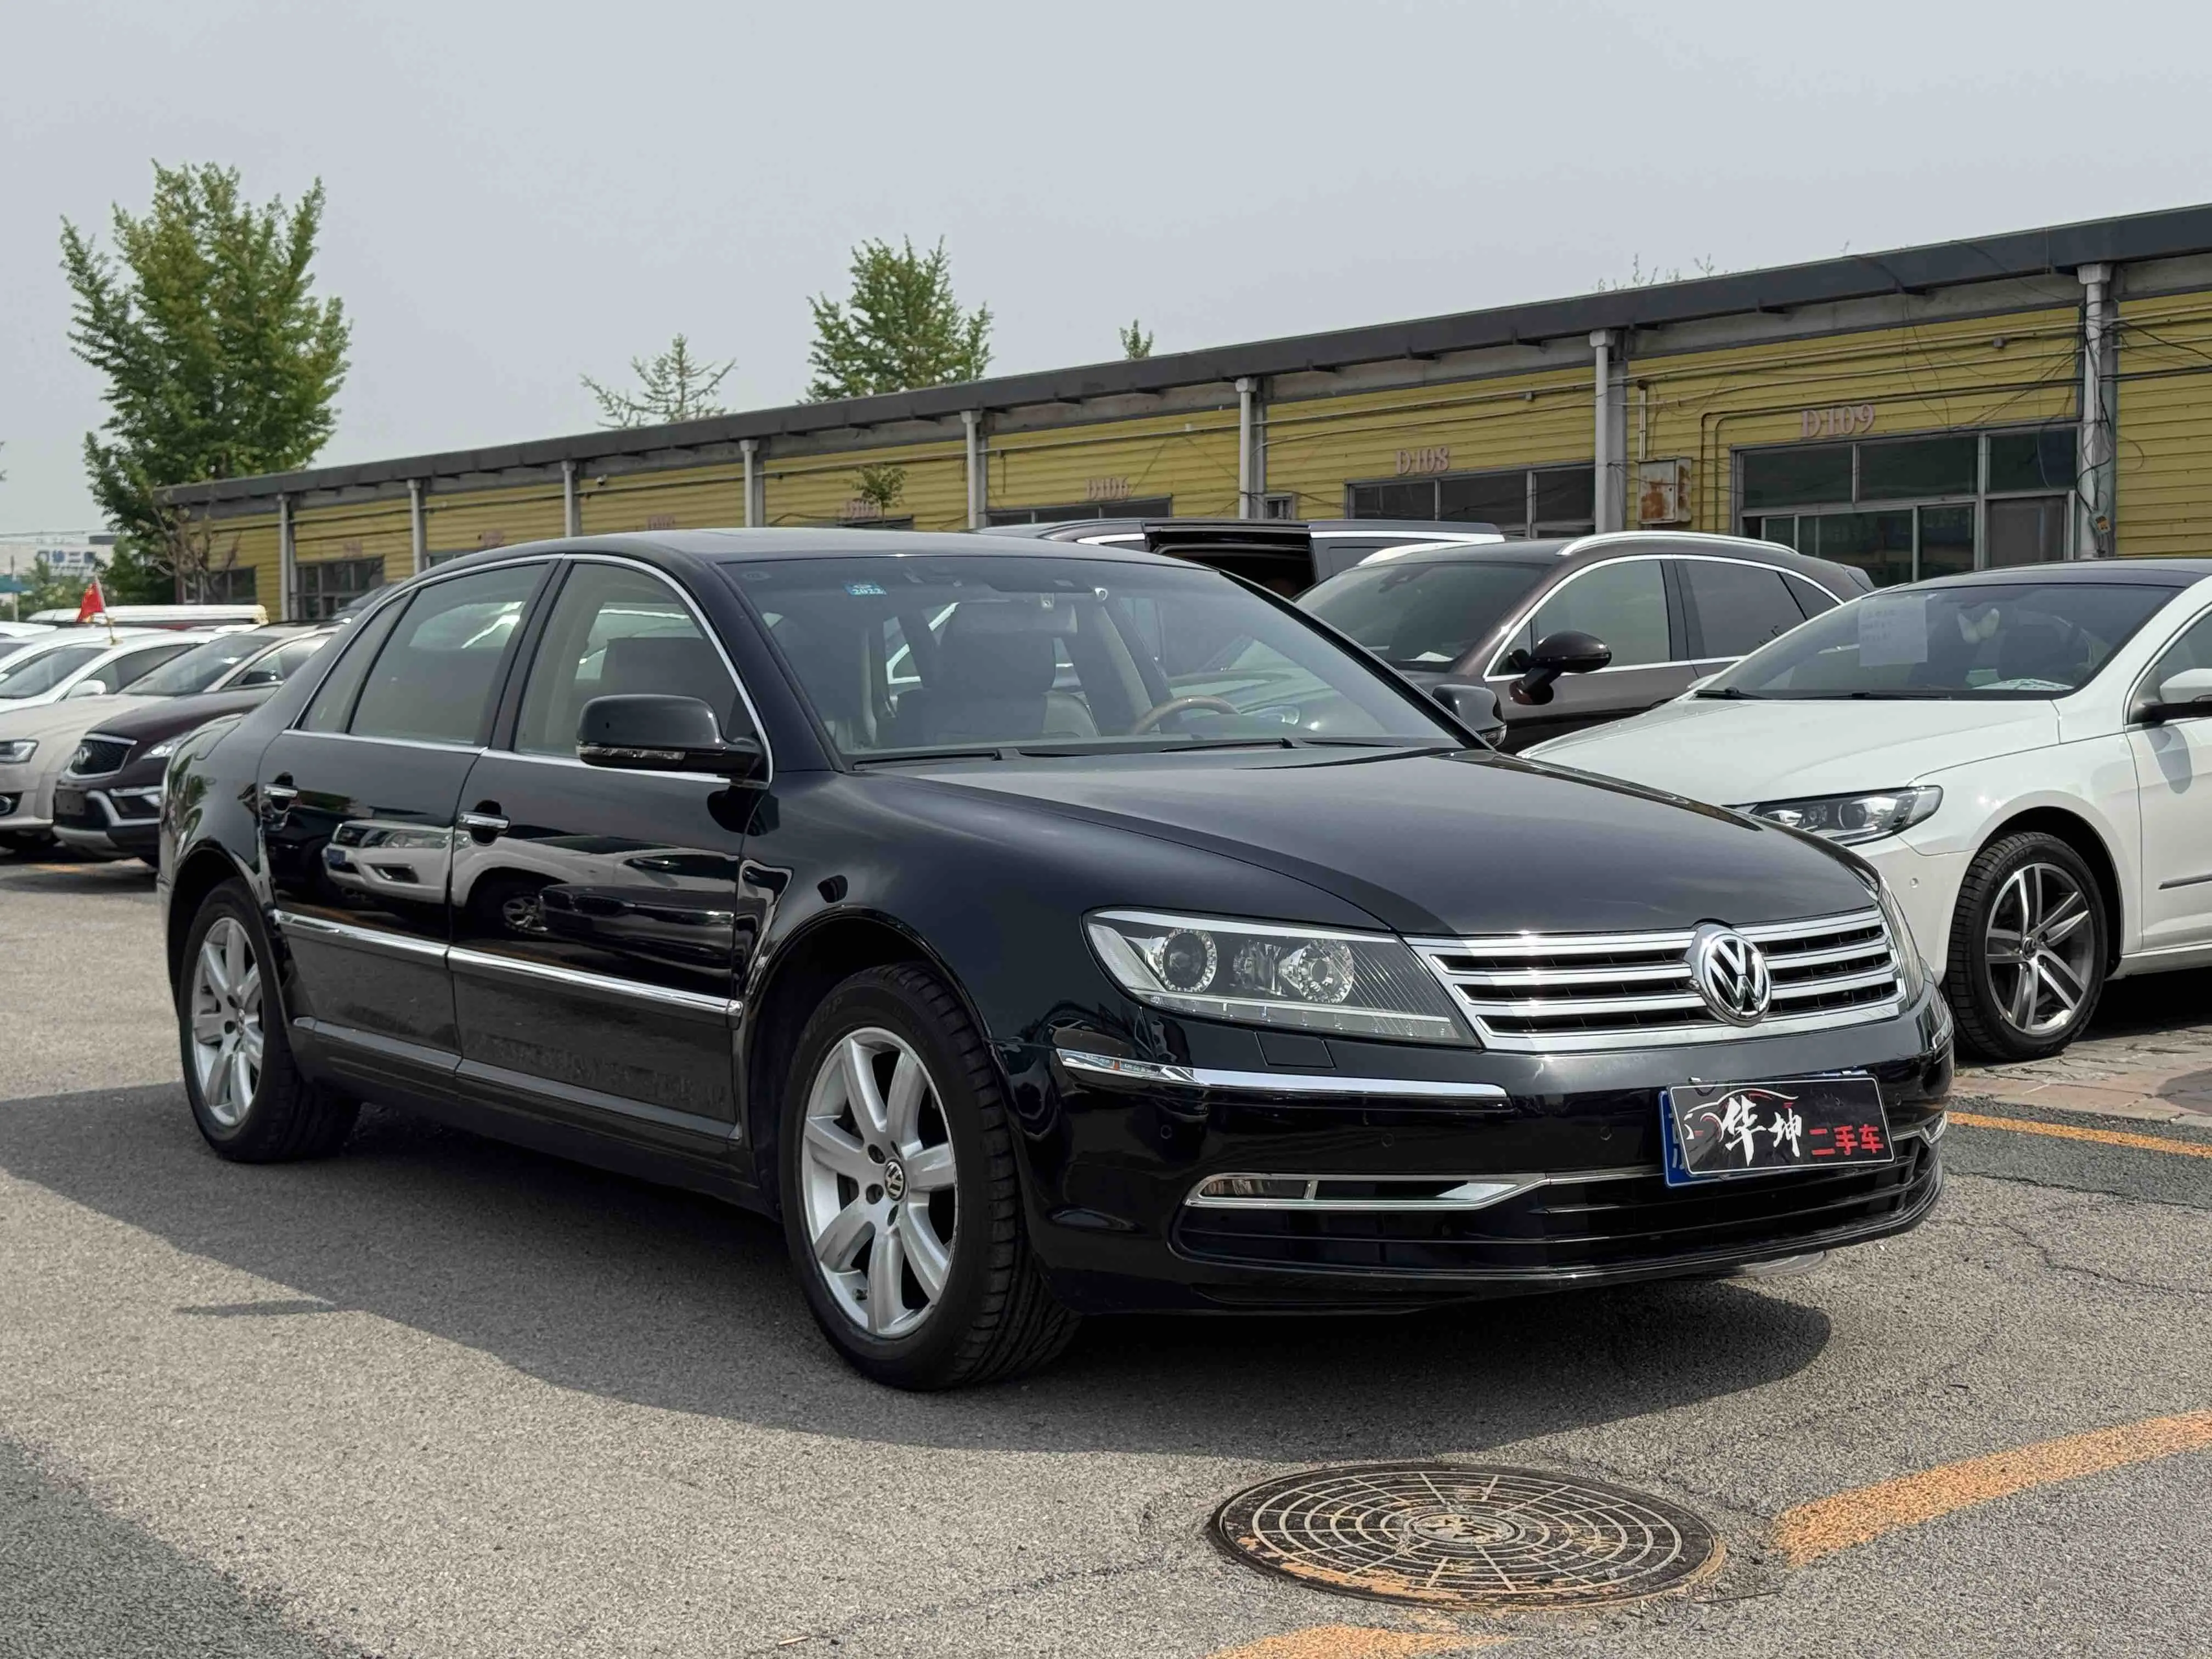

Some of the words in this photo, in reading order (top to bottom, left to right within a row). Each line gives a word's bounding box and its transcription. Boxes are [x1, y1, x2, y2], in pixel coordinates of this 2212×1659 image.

[1802, 404, 1875, 438] D109
[1396, 447, 1449, 475] D108
[1722, 1095, 1802, 1167] 华坤
[1809, 1124, 1883, 1156] 二手车
